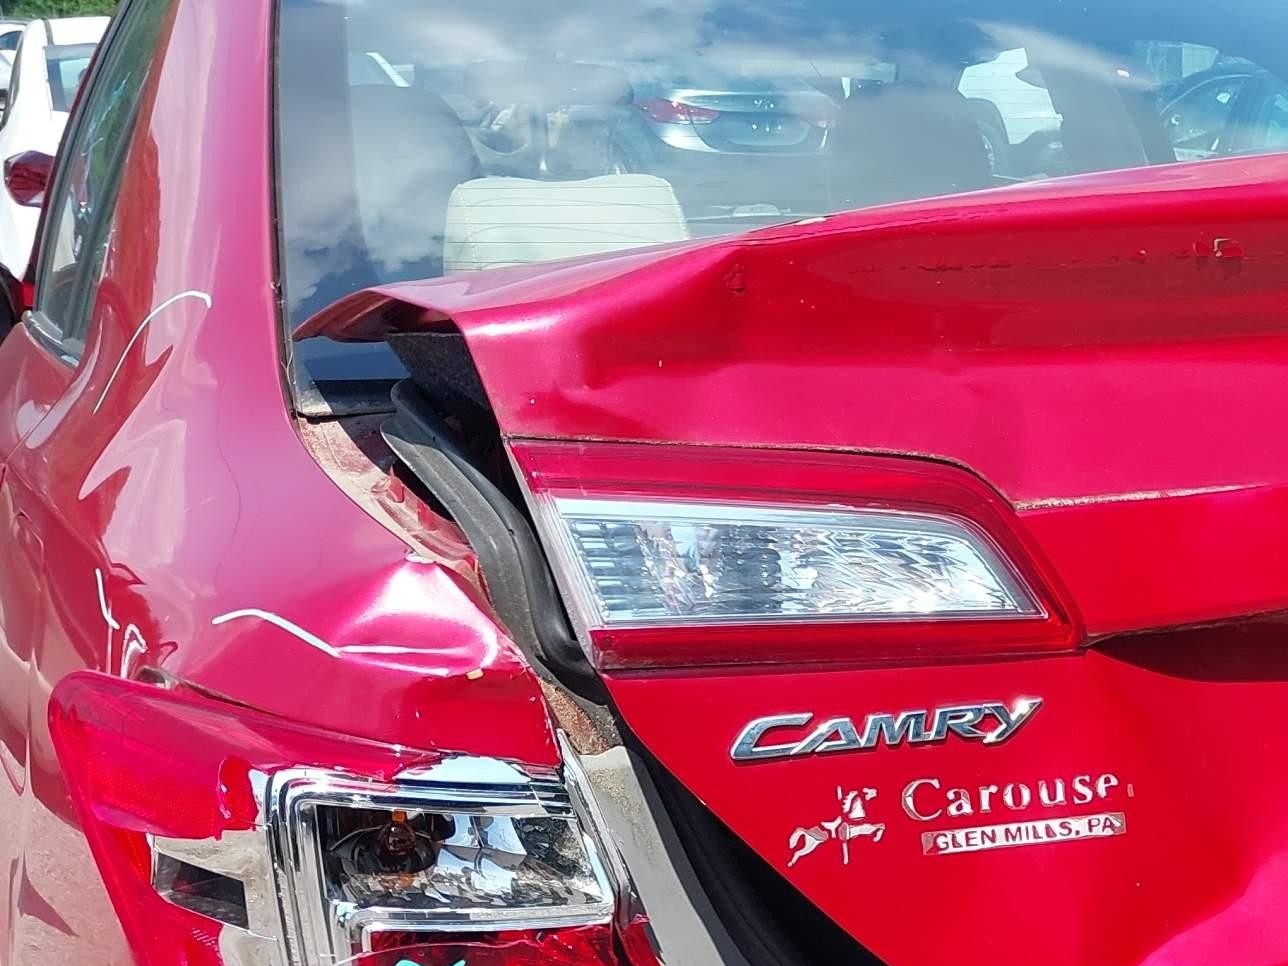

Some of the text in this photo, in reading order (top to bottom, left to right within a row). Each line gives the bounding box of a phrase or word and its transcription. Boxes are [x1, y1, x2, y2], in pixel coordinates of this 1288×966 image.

[730, 698, 1044, 761] CAMRY
[901, 772, 1135, 822] Carouse
[934, 828, 997, 852] GLEN
[1087, 815, 1120, 834] PA
